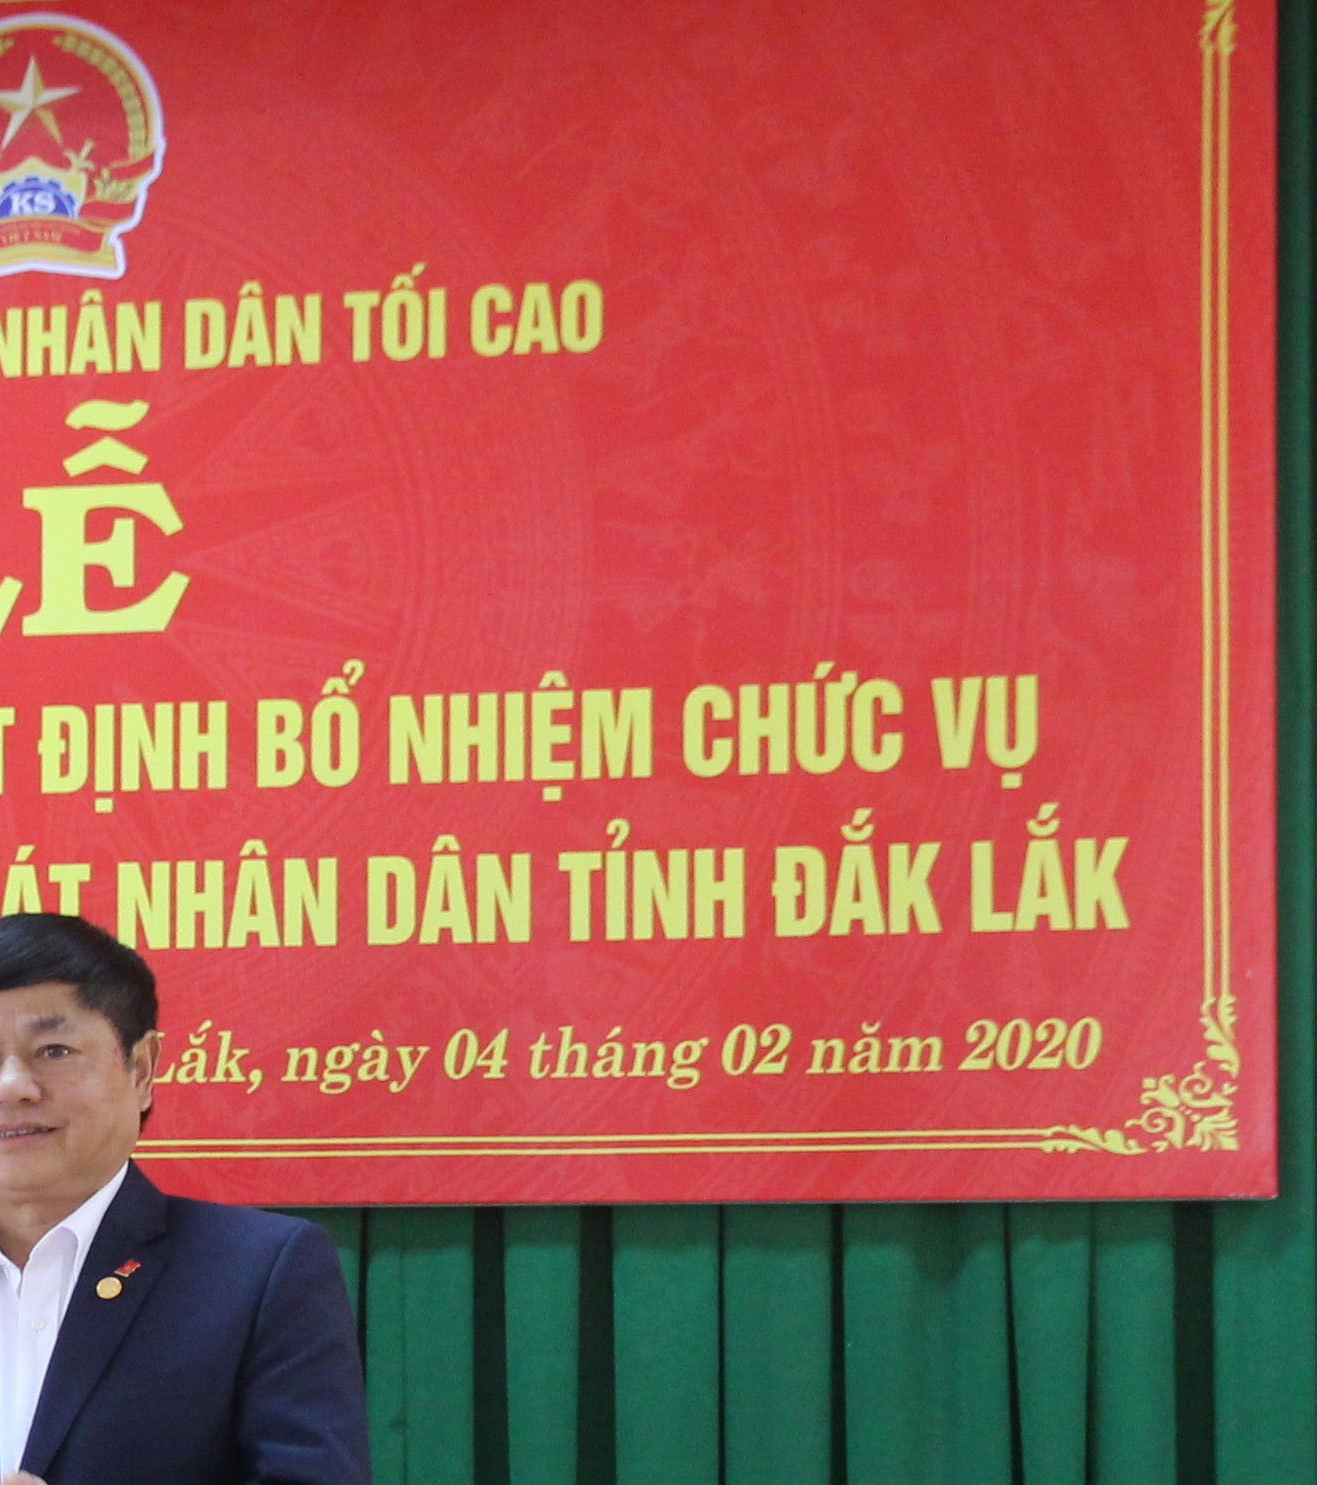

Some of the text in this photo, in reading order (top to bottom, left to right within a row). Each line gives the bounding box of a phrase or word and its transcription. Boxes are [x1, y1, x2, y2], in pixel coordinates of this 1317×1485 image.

[9, 189, 56, 216] KS
[185, 281, 321, 369] DÂN
[344, 264, 446, 361] TỐI
[471, 280, 602, 356] CAO
[38, 701, 227, 813] ĐỊNH
[257, 659, 364, 788] BỔ
[389, 670, 652, 801] NHIỆM
[683, 662, 902, 777] CHỨC
[932, 675, 1037, 788] VỤ
[117, 838, 339, 951] NHÂN
[367, 834, 531, 945] DÂN
[559, 819, 744, 941] TỈNH
[772, 808, 941, 936] ĐẮK
[971, 803, 1129, 932] LẮK
[281, 1030, 429, 1094] ngày
[444, 1029, 508, 1079] 04
[530, 1026, 709, 1089] tháng
[722, 1024, 791, 1075] 02
[807, 1023, 941, 1073] năm
[959, 1018, 1102, 1070] 2020
